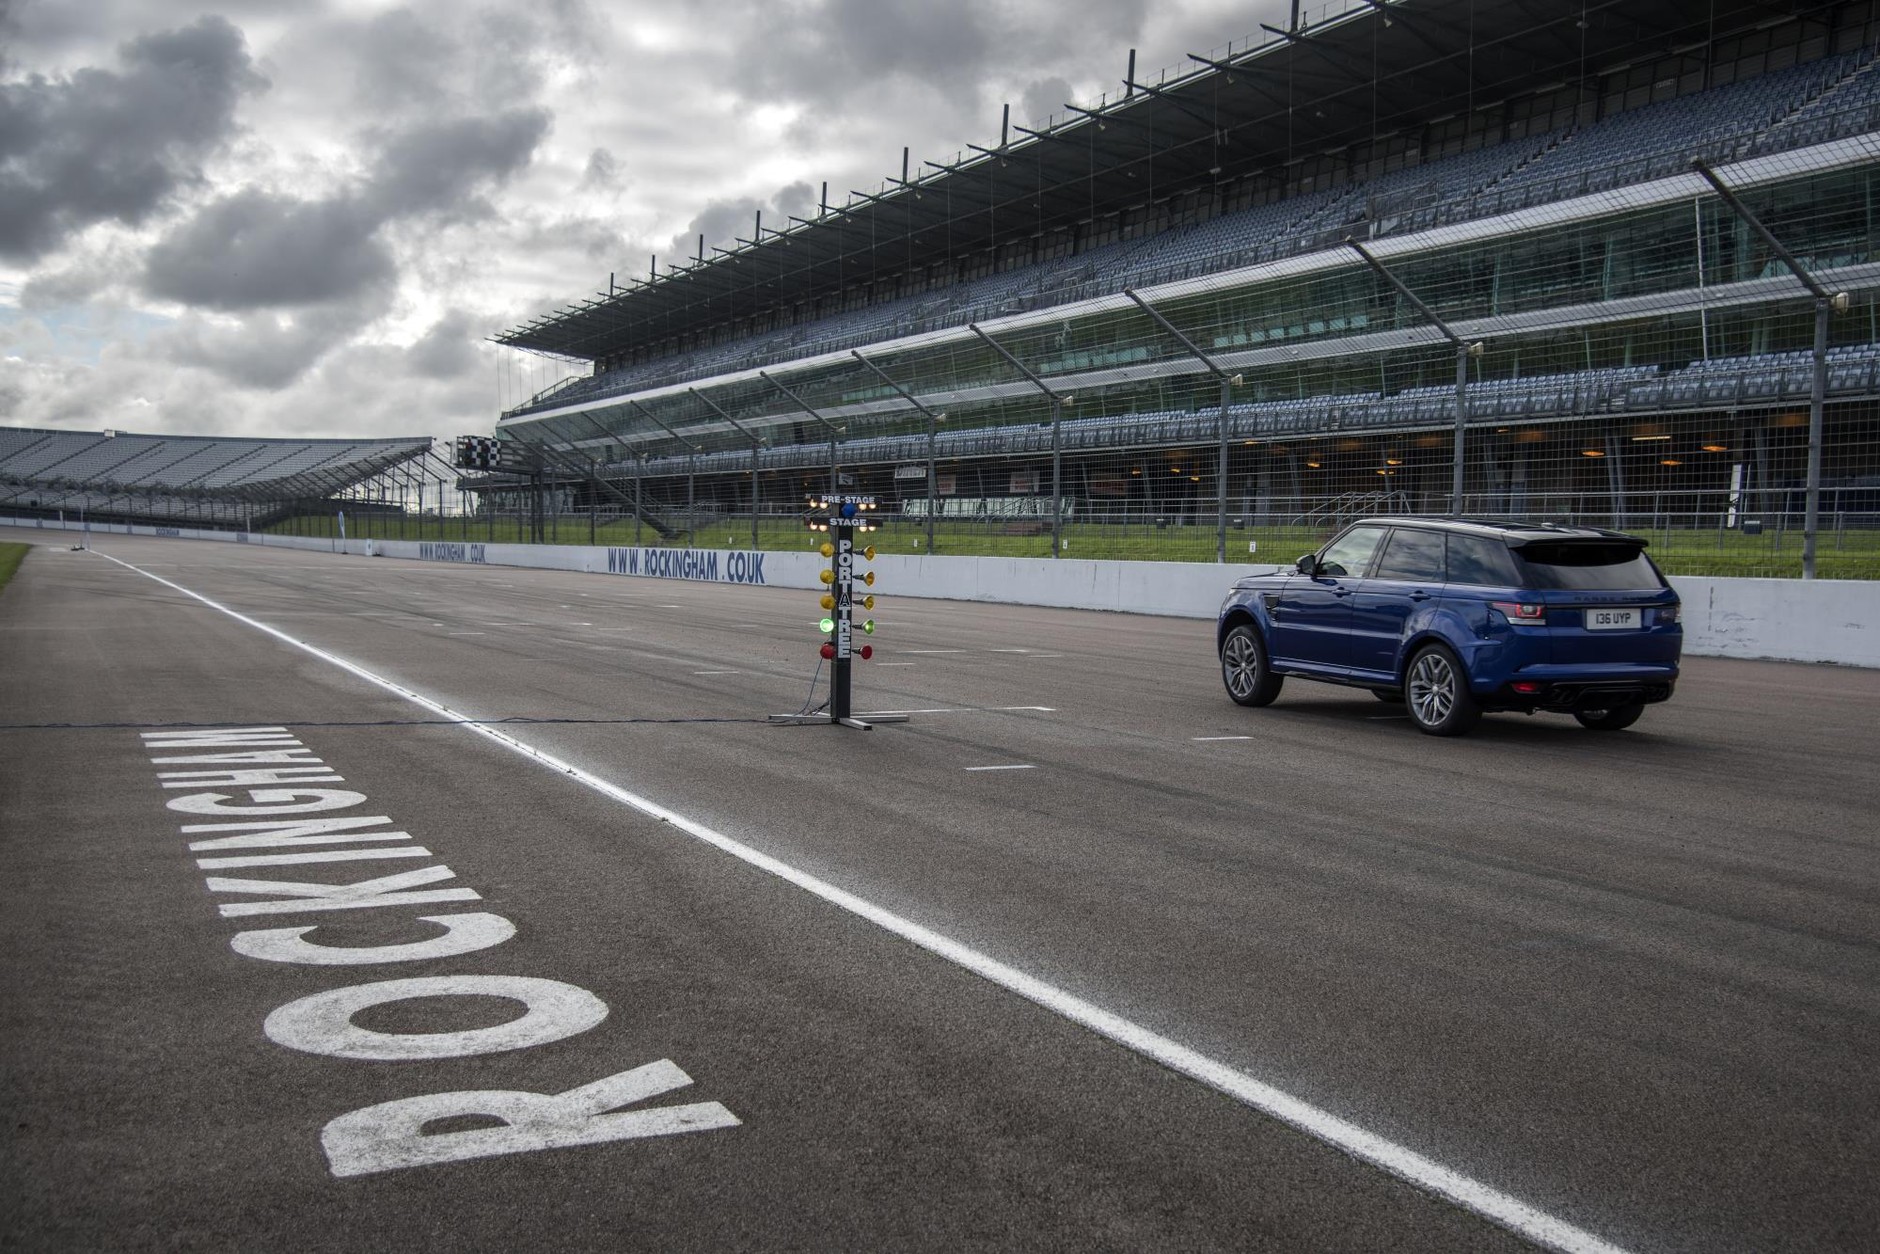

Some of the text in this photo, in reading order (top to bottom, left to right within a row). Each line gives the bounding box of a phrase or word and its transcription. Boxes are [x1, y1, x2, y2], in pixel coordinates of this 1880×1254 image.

[821, 495, 876, 504] PRE-STAGE
[830, 518, 867, 527] STAGE
[1612, 611, 1632, 624] UYP
[140, 725, 743, 1178] ROCKINGHAM
